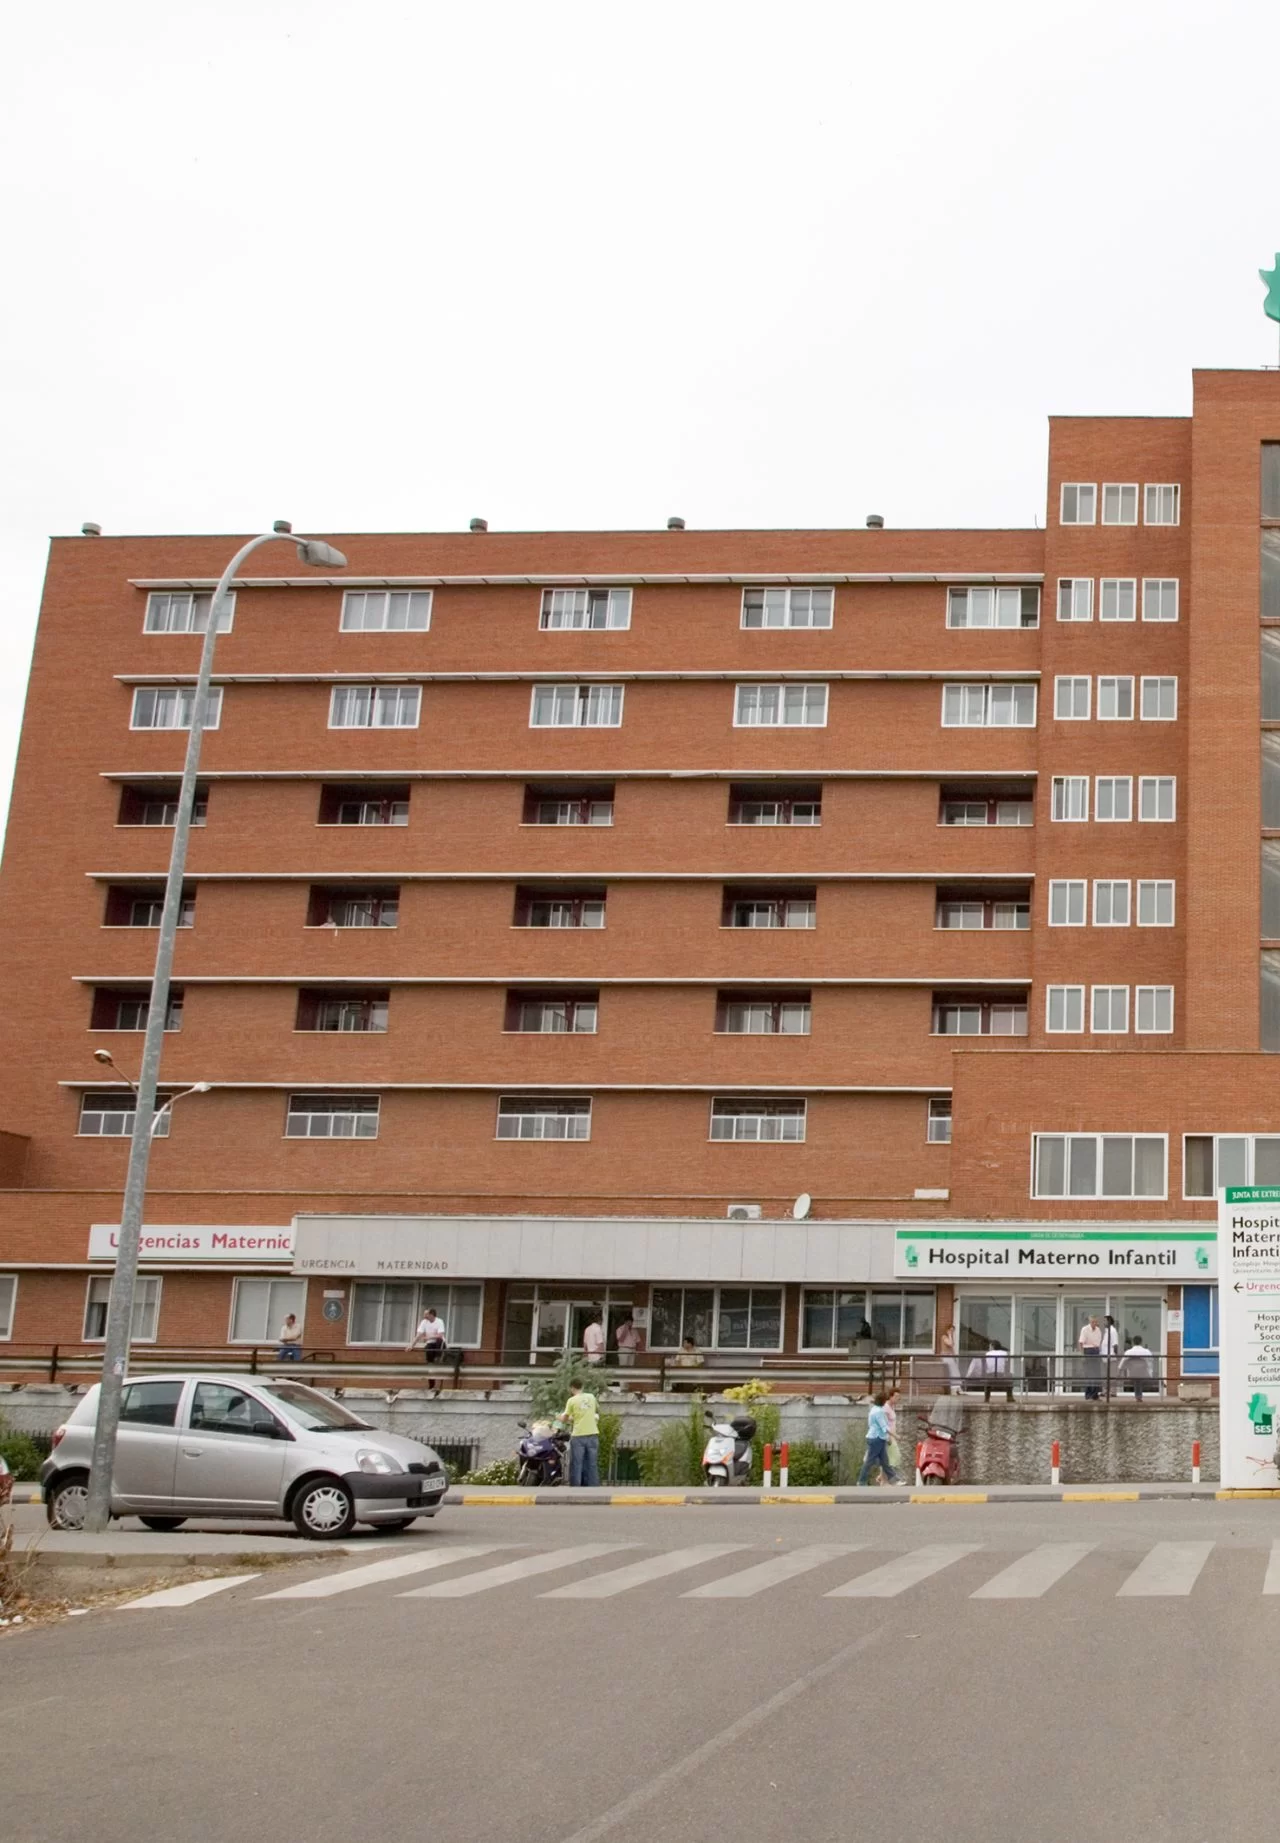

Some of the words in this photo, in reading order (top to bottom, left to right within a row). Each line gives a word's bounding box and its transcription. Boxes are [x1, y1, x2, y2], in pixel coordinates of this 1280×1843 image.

[1232, 1191, 1251, 1199] JUNTA
[110, 1232, 200, 1252] Ugencias
[928, 1248, 1009, 1268] Hospital
[1018, 1249, 1100, 1265] Materno
[1108, 1249, 1177, 1266] Infantil
[302, 1260, 356, 1269] URGENCIA
[377, 1261, 449, 1270] MATERNIDAD
[1254, 1425, 1272, 1433] SES
